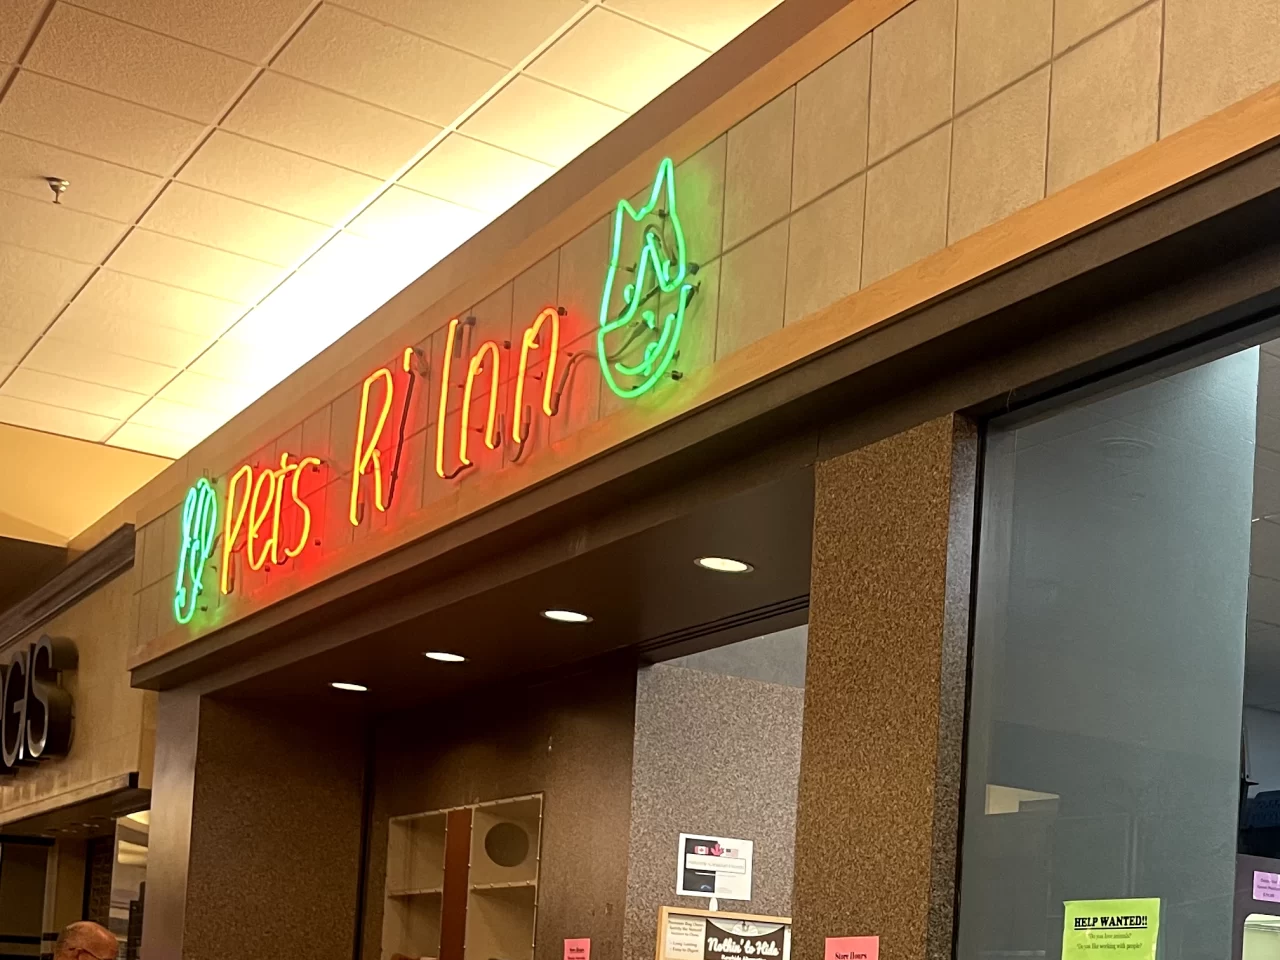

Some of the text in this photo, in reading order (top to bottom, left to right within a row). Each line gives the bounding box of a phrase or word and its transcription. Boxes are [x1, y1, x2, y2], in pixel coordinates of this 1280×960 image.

[221, 452, 320, 595] Pets
[436, 307, 559, 479] Inn
[1074, 915, 1148, 928] HELP WANTED!!
[707, 937, 744, 954] Nothin'
[744, 938, 755, 955] to
[849, 951, 867, 960] Hours
